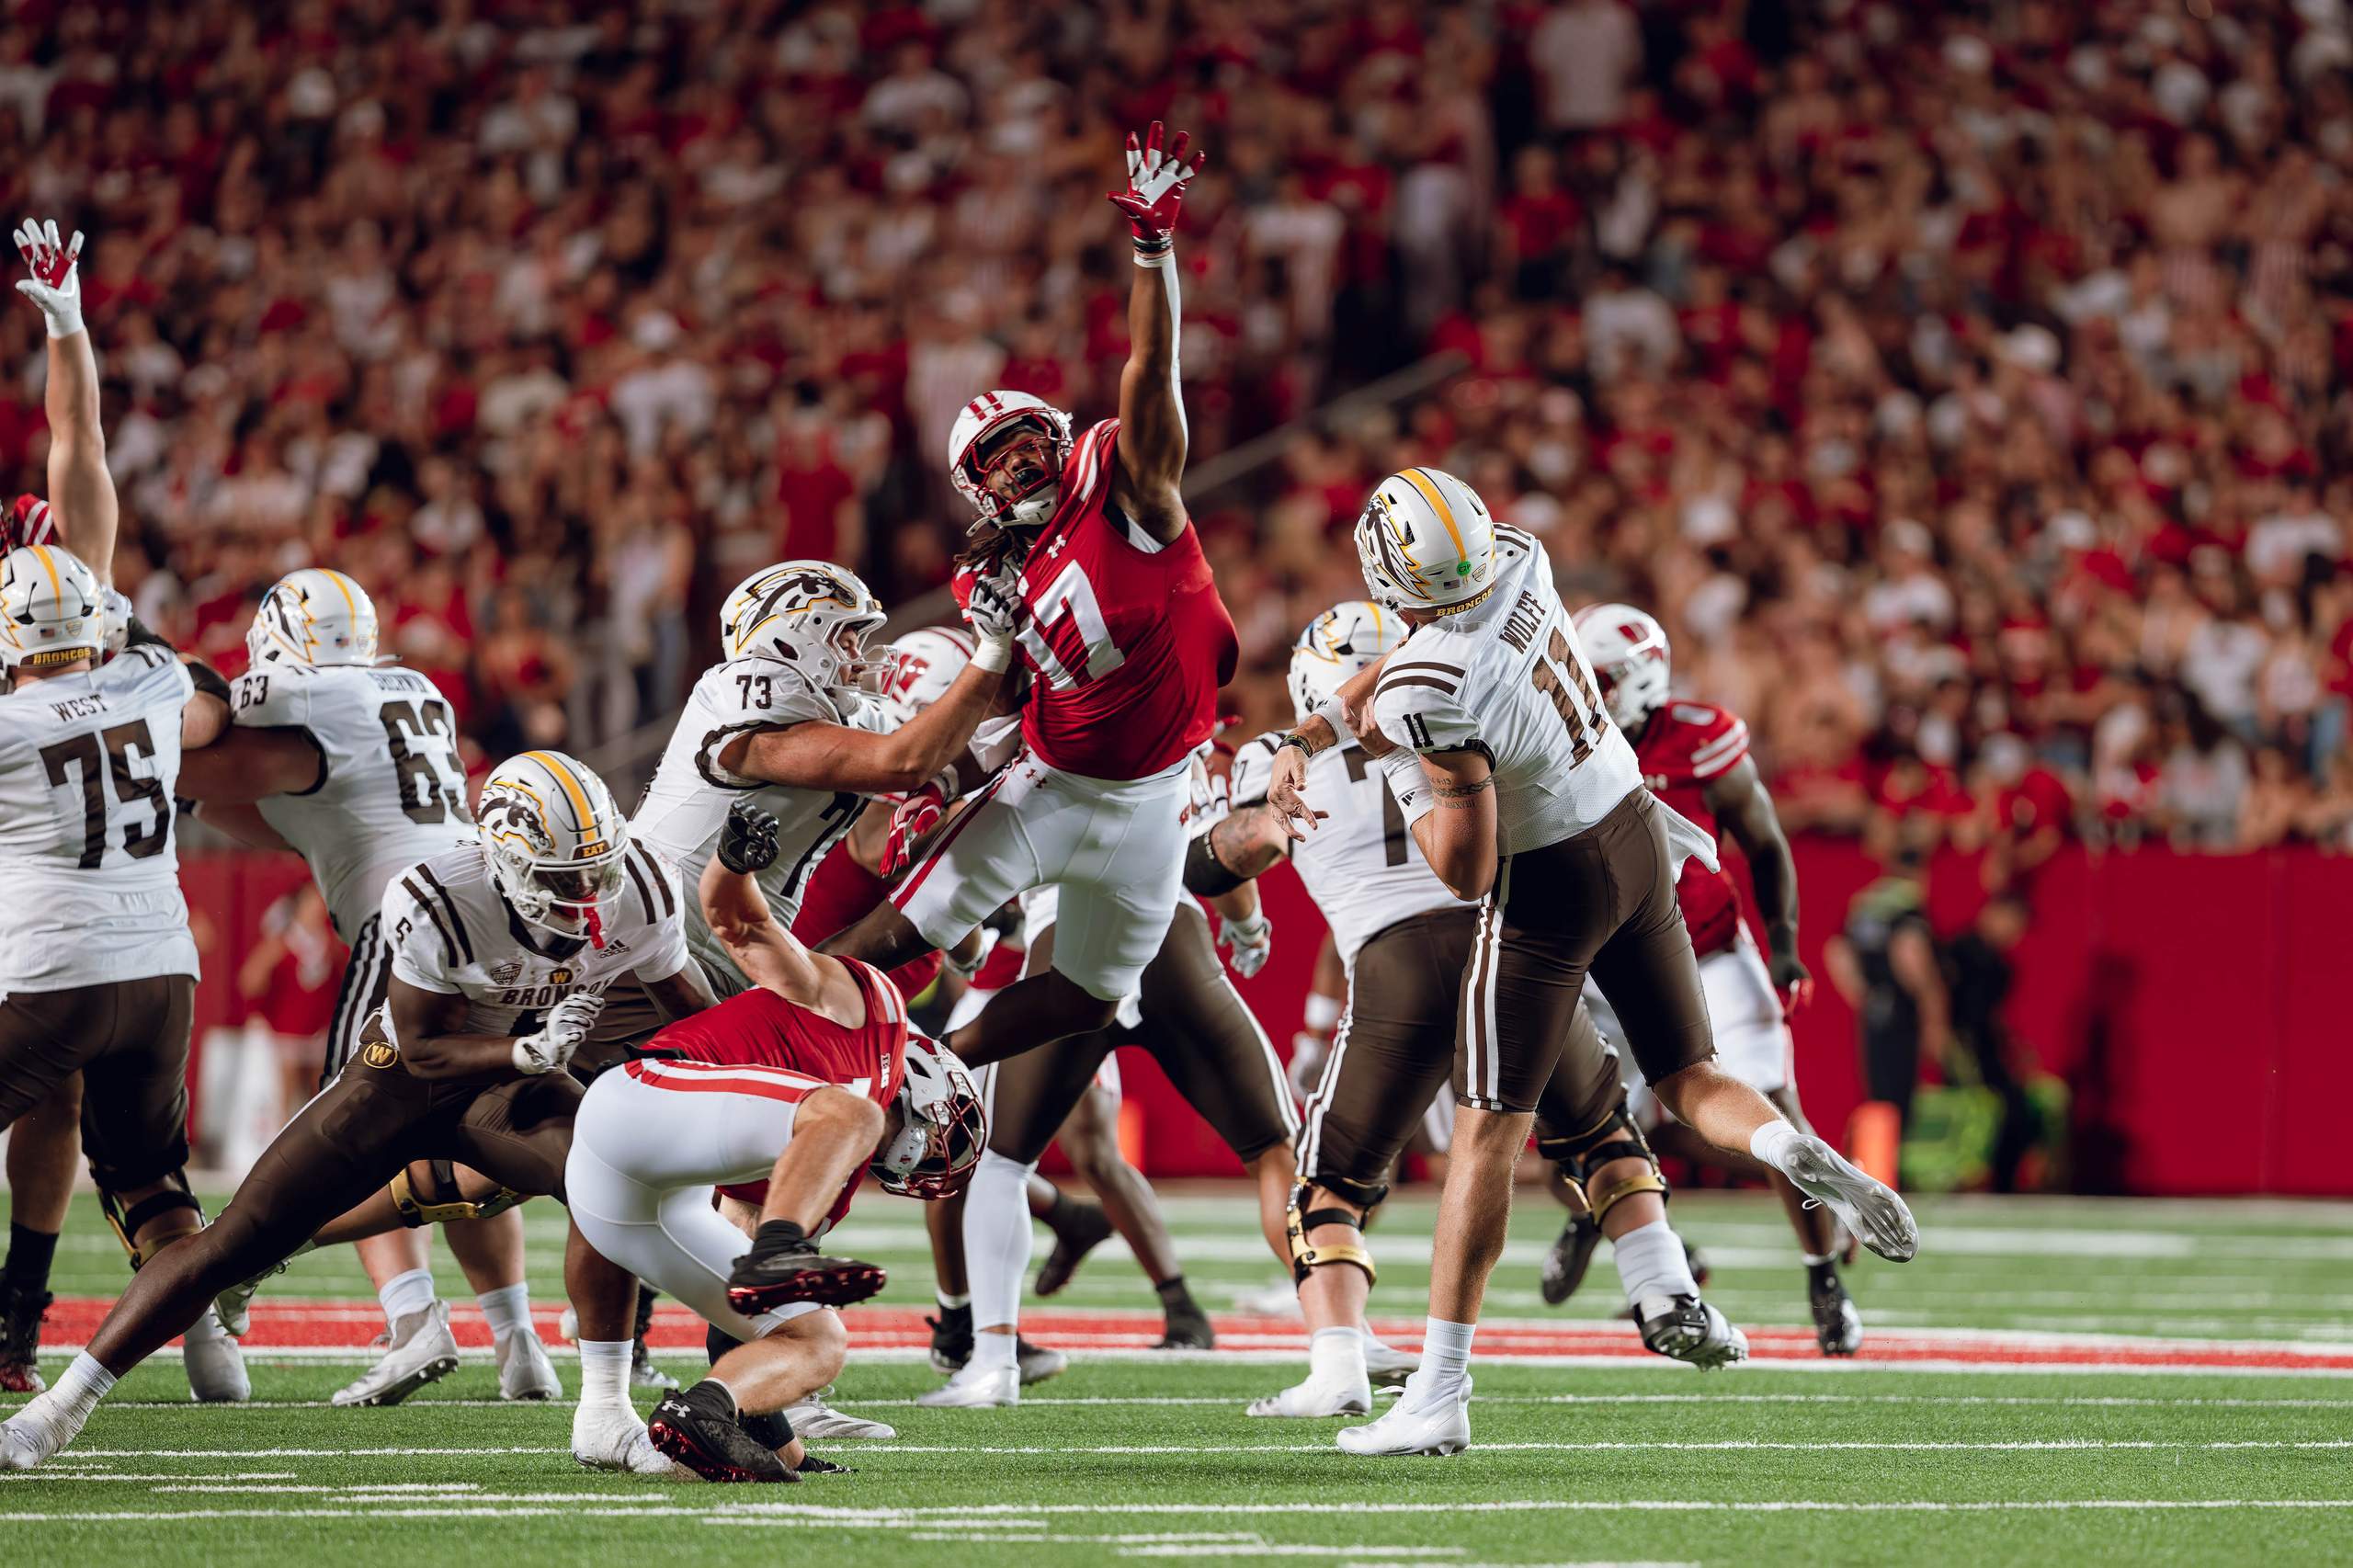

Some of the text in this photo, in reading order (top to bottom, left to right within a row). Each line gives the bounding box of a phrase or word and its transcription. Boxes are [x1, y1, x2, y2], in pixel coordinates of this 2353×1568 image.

[1435, 587, 1494, 617] BRONCOS
[1015, 559, 1126, 691] 17
[1499, 590, 1546, 654] WOLFF
[33, 647, 92, 665] BRONCOS
[49, 693, 108, 722] WEST
[240, 675, 268, 709] 63
[736, 675, 772, 710] 73
[1532, 626, 1608, 770] 11
[1403, 712, 1434, 748] 11
[39, 718, 171, 870] 75
[583, 842, 605, 858] EAT
[599, 946, 631, 960] adidas
[551, 971, 569, 984] W
[370, 1044, 393, 1063] W
